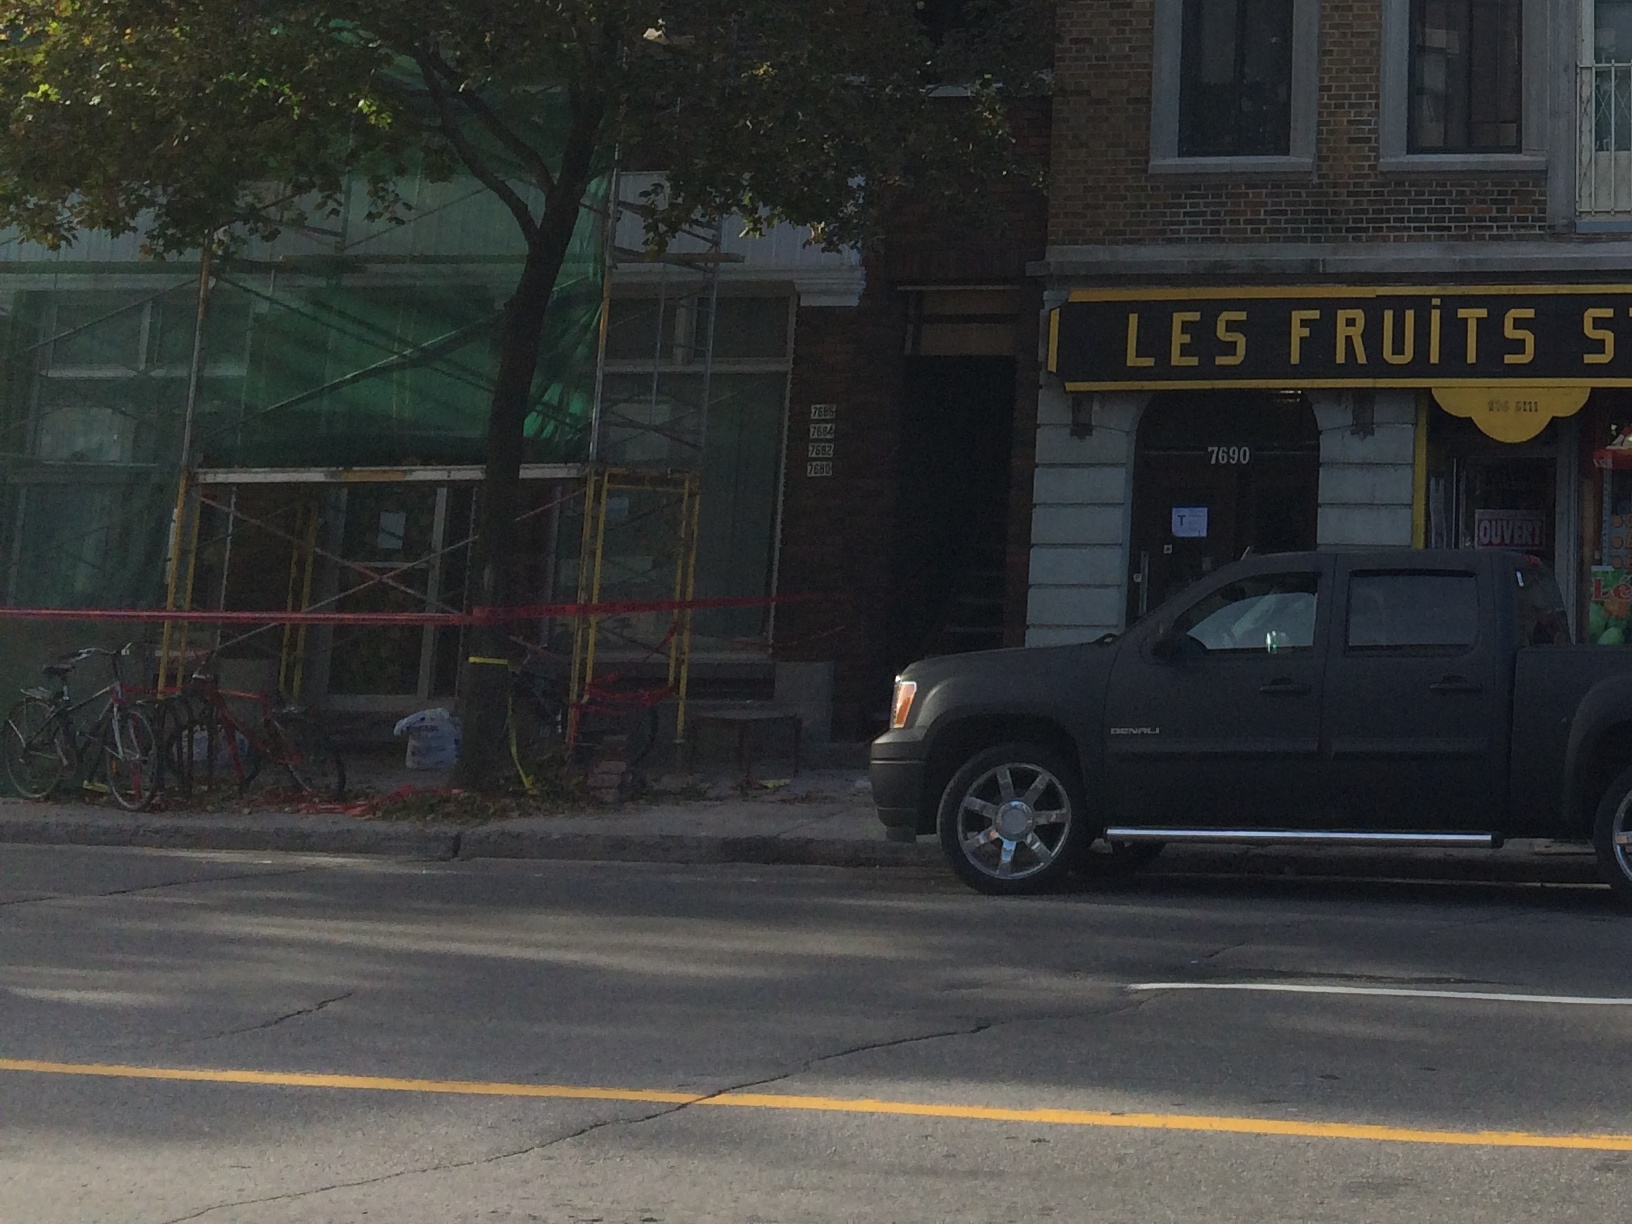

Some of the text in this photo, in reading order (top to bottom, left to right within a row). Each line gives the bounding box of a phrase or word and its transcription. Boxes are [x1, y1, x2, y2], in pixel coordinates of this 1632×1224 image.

[1125, 310, 1248, 367] LES
[1207, 446, 1251, 465] 7690
[1479, 519, 1542, 545] OUVERT
[1110, 727, 1160, 735] DENALI
